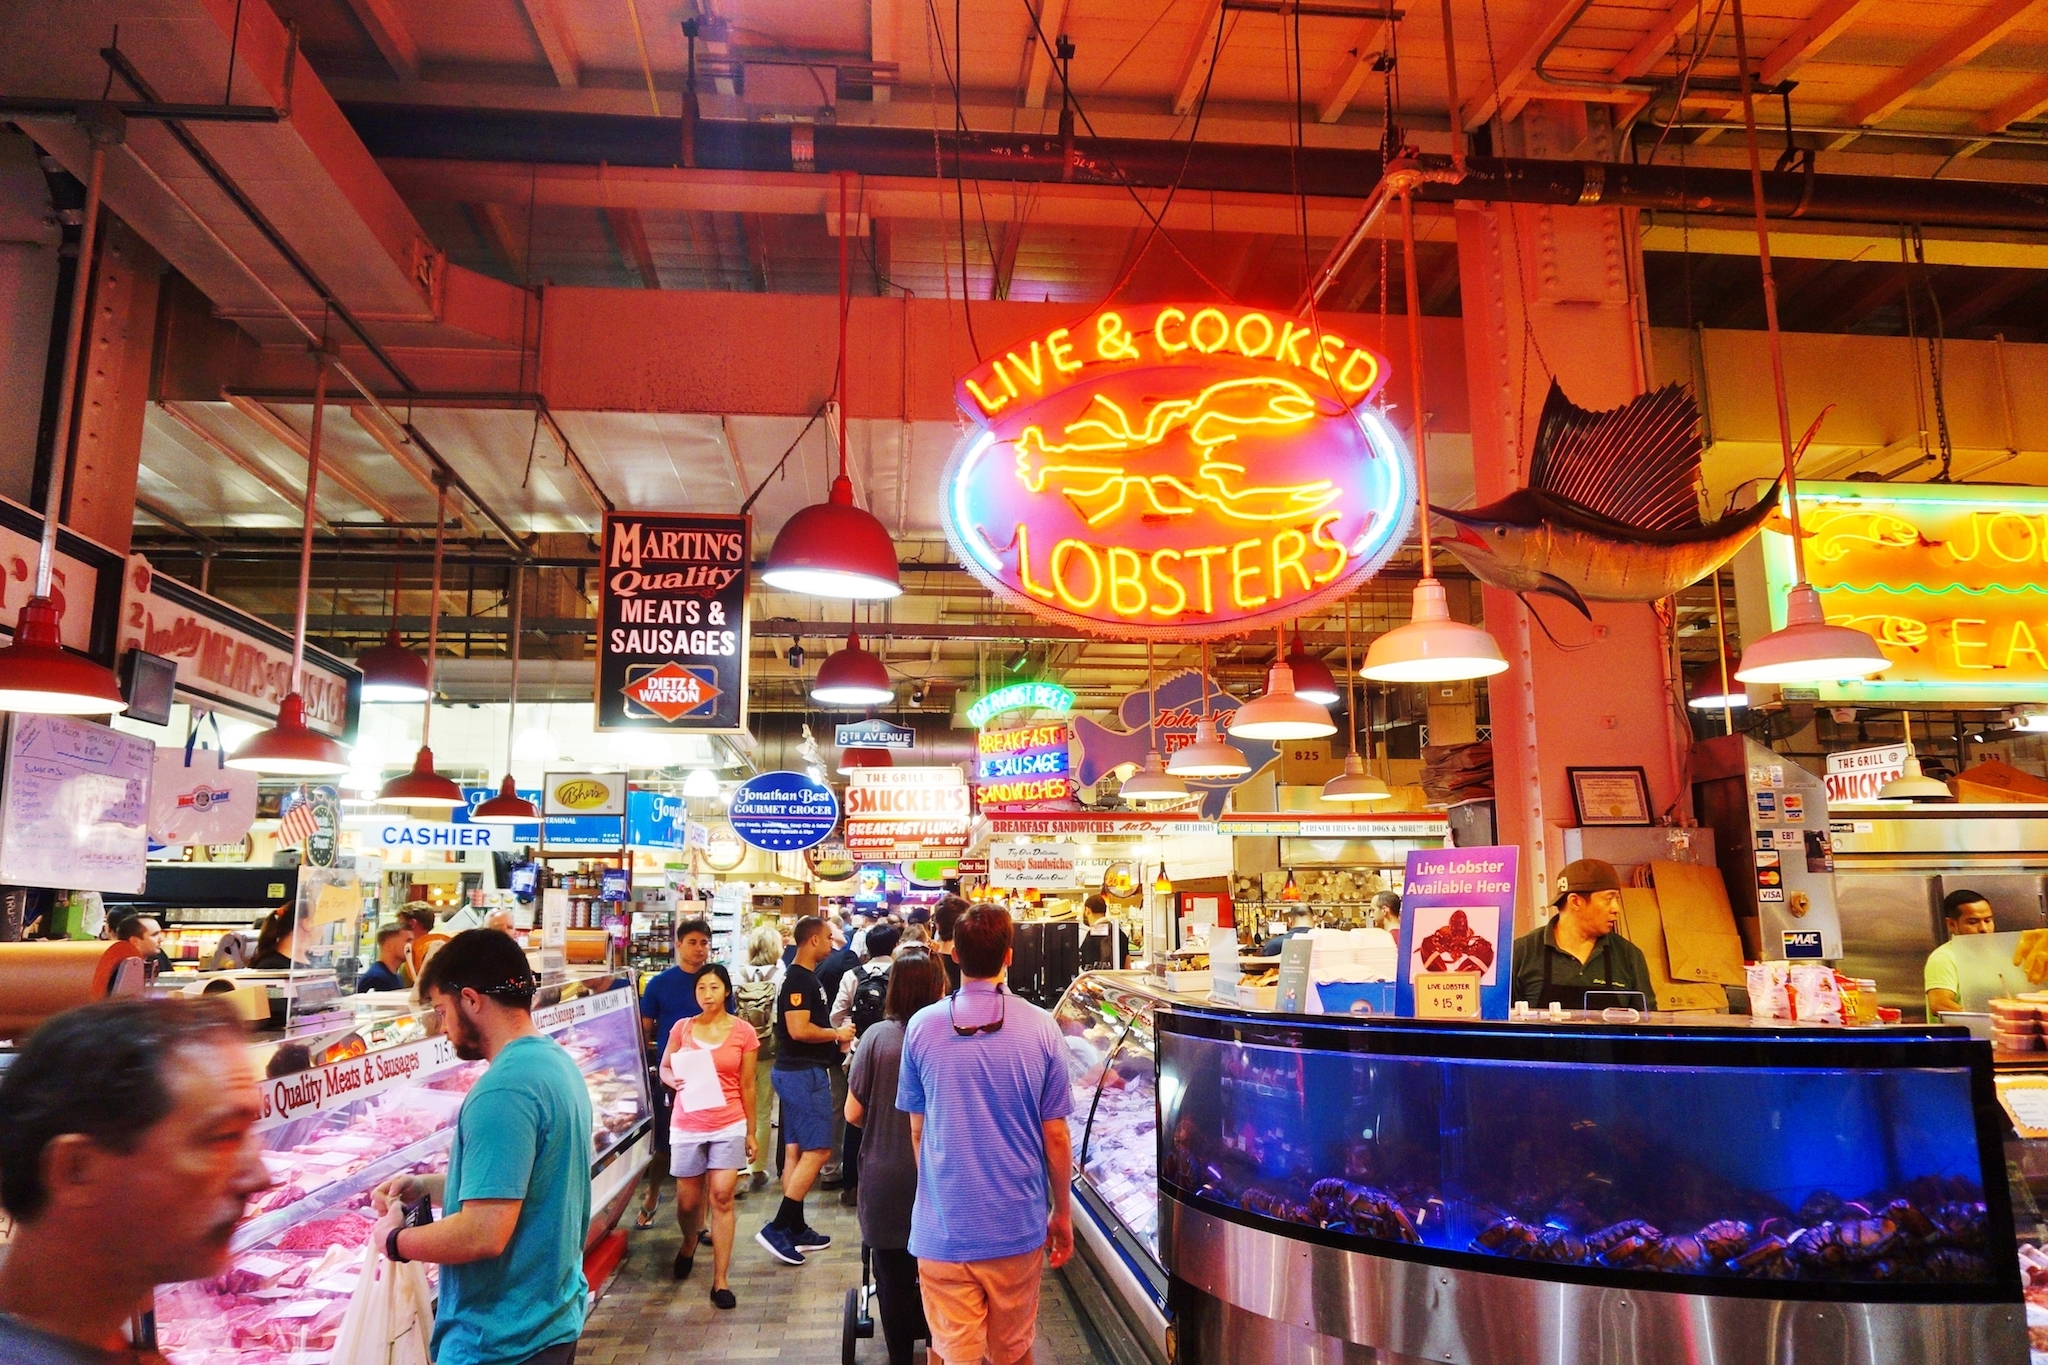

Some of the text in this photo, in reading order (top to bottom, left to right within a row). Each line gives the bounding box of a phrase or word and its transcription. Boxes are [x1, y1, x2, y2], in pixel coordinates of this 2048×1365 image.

[965, 307, 1379, 412] LIVE & COOKED
[609, 522, 743, 569] MARTIN'S
[1018, 511, 1348, 616] LOBSTERS
[610, 566, 742, 597] Quality
[620, 599, 726, 626] MEATS &
[610, 628, 736, 656] SAUSAGES
[198, 626, 268, 698] MEATS
[647, 677, 701, 690] DIETZ &
[638, 689, 700, 703] WATSON
[989, 685, 1034, 711] ROAST
[1034, 685, 1070, 712] BEEF
[839, 731, 911, 744] 8TH AVENUE
[979, 726, 1060, 753] BREAKFAST
[1294, 750, 1320, 761] 825
[1837, 758, 1855, 769] THE
[1857, 753, 1884, 767] GRILL
[979, 752, 1061, 777] & SAUSAGE
[865, 773, 888, 783] THE
[892, 773, 926, 783] GRILL
[177, 791, 229, 807] Hot Cold
[736, 787, 830, 804] Jonathan Best
[977, 778, 1066, 805] SANDWICHES
[848, 788, 964, 813] SMUCKER'S
[734, 804, 833, 815] GOURMET GROCER
[847, 822, 921, 836] BREAKFAST
[926, 821, 967, 835] LUNCH
[992, 821, 1168, 834] BREAKFAST SANDWICHES All Day!
[1305, 824, 1331, 833] FRENCH
[1332, 824, 1351, 833] FRIES
[1357, 824, 1371, 833] HOT
[1371, 824, 1390, 833] DOGS
[1391, 824, 1397, 833] &
[1428, 824, 1444, 833] BEEF
[381, 826, 491, 846] CASHIER
[849, 837, 967, 847] SERVED ALL DAY
[1782, 831, 1795, 840] EBT
[810, 849, 852, 861] CANTIN
[861, 851, 885, 859] TENDER
[885, 851, 897, 859] POT
[897, 851, 916, 859] ROAST
[916, 851, 931, 859] BEEF
[931, 850, 961, 858] SANDWICH
[1007, 848, 1018, 857] Try
[958, 862, 977, 871] Order
[993, 858, 1074, 872] Sausage Sandwiches
[1416, 860, 1505, 876] Live Lobster
[1004, 873, 1016, 881] You
[1050, 873, 1068, 881] One!
[1406, 880, 1511, 896] Available Here
[1762, 890, 1782, 899] VISA
[1792, 933, 1819, 945] MAC
[274, 1073, 322, 1119] Quality
[324, 1066, 361, 1098] Meats
[363, 1057, 375, 1085] &
[376, 1050, 420, 1080] Sausages
